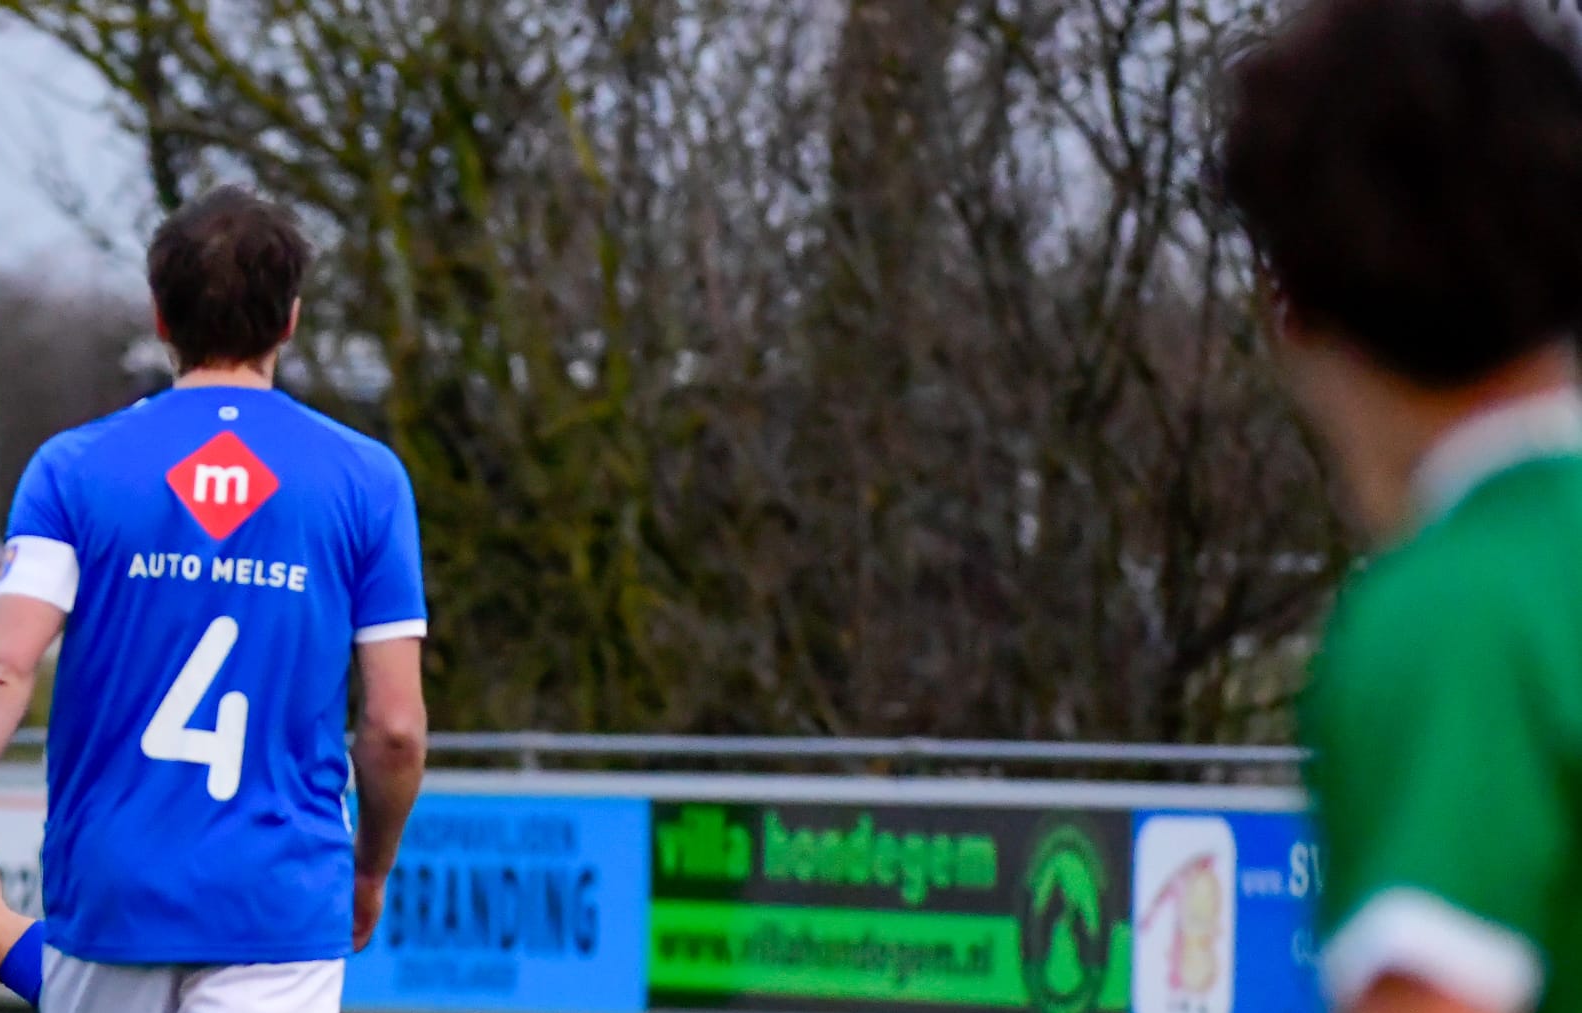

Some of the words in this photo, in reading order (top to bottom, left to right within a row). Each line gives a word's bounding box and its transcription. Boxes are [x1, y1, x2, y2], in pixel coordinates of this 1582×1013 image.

[128, 552, 201, 582] AUTO
[211, 555, 308, 592] MELSE
[140, 615, 249, 801] 4
[657, 803, 753, 881] villa
[763, 810, 998, 905] hondegem
